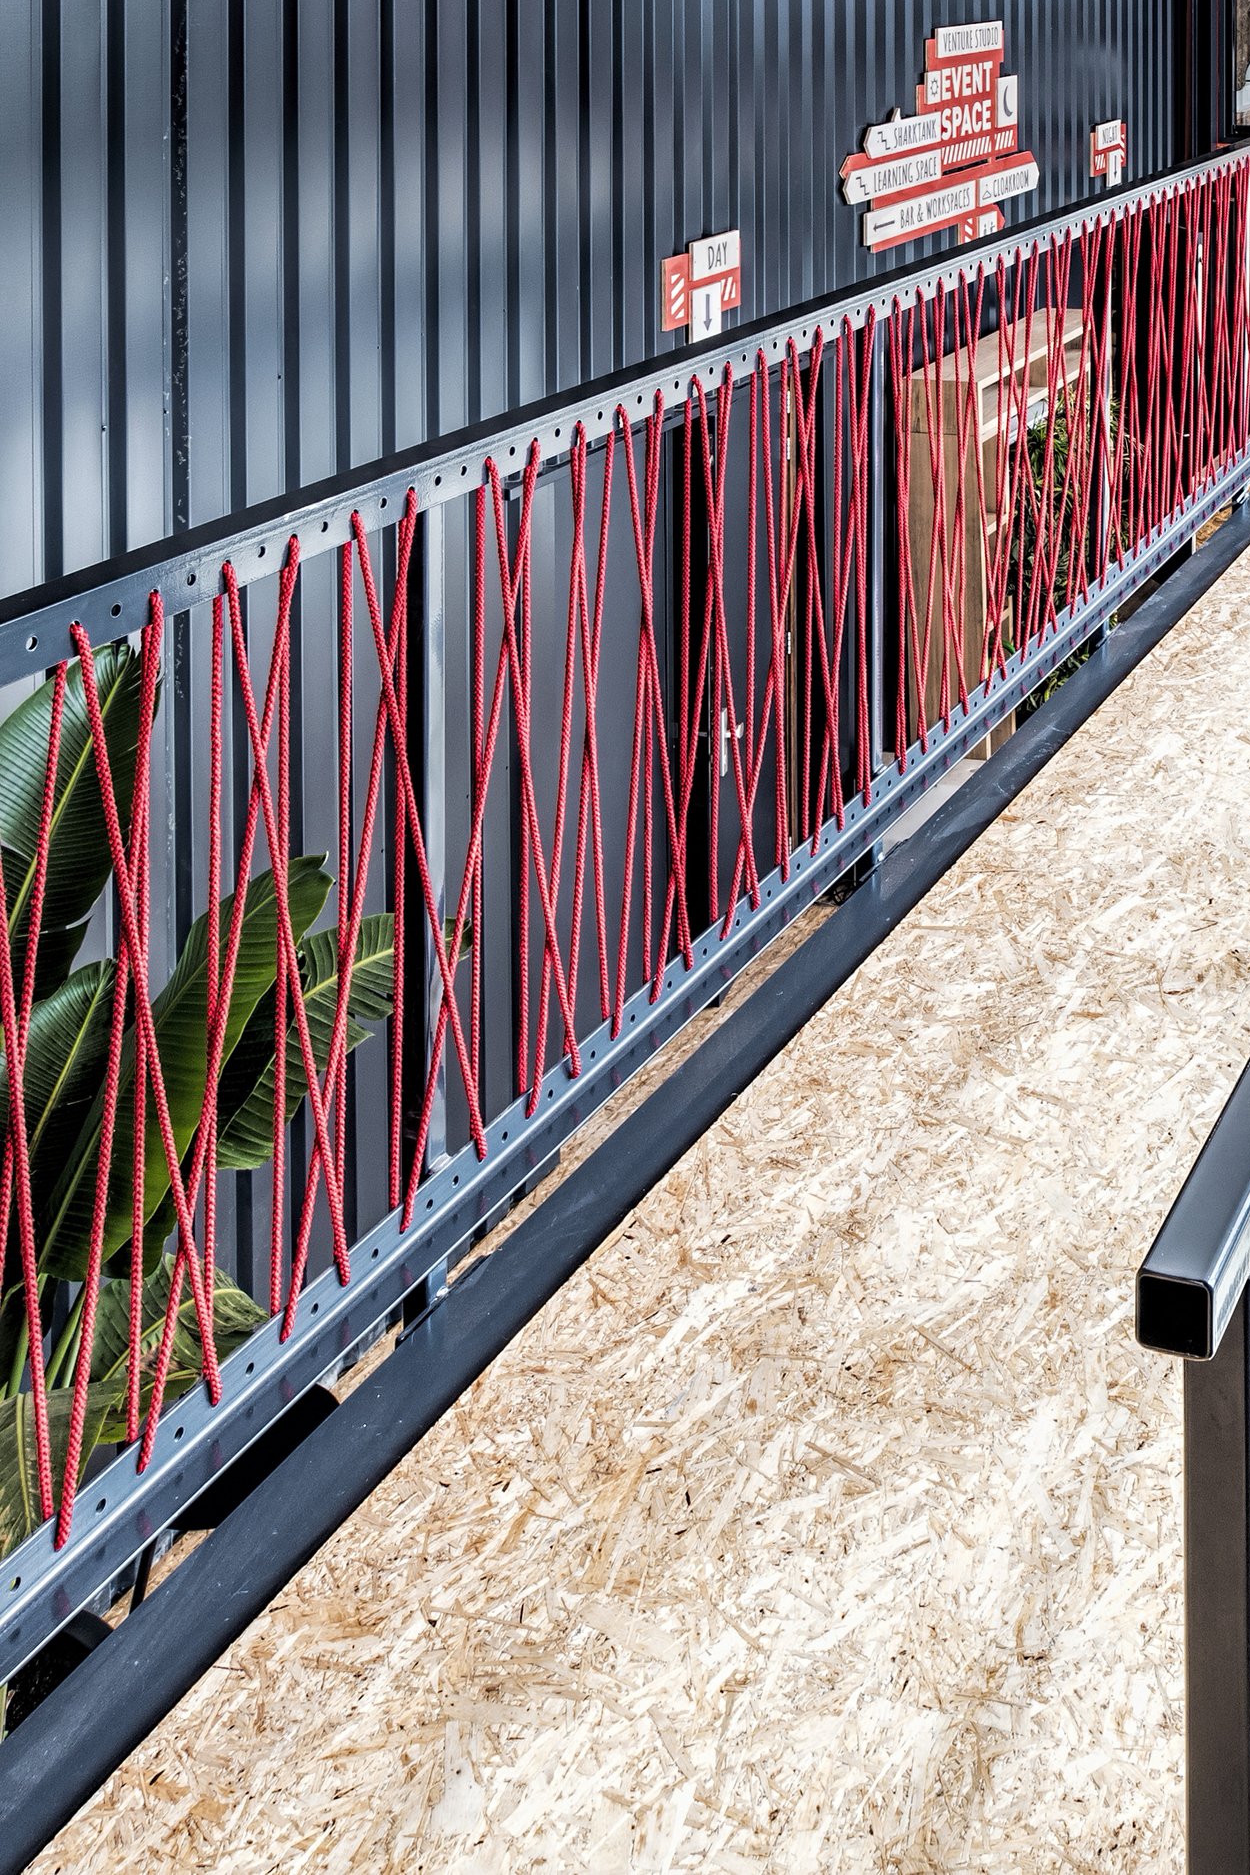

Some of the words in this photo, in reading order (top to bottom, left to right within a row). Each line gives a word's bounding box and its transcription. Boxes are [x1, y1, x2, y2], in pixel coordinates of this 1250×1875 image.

[943, 28, 973, 53] VENTURE
[974, 27, 999, 48] STUDIO
[941, 61, 993, 101] EVENT
[893, 119, 937, 149] SHARKTANK
[941, 99, 992, 141] SPACE
[873, 162, 914, 193] LEARNING
[915, 156, 937, 182] SPACE
[992, 169, 1029, 198] CLOAKROOM
[900, 206, 914, 229] BAR
[917, 203, 924, 223] &
[925, 187, 971, 219] WORKSPACES
[707, 241, 727, 270] DAY
